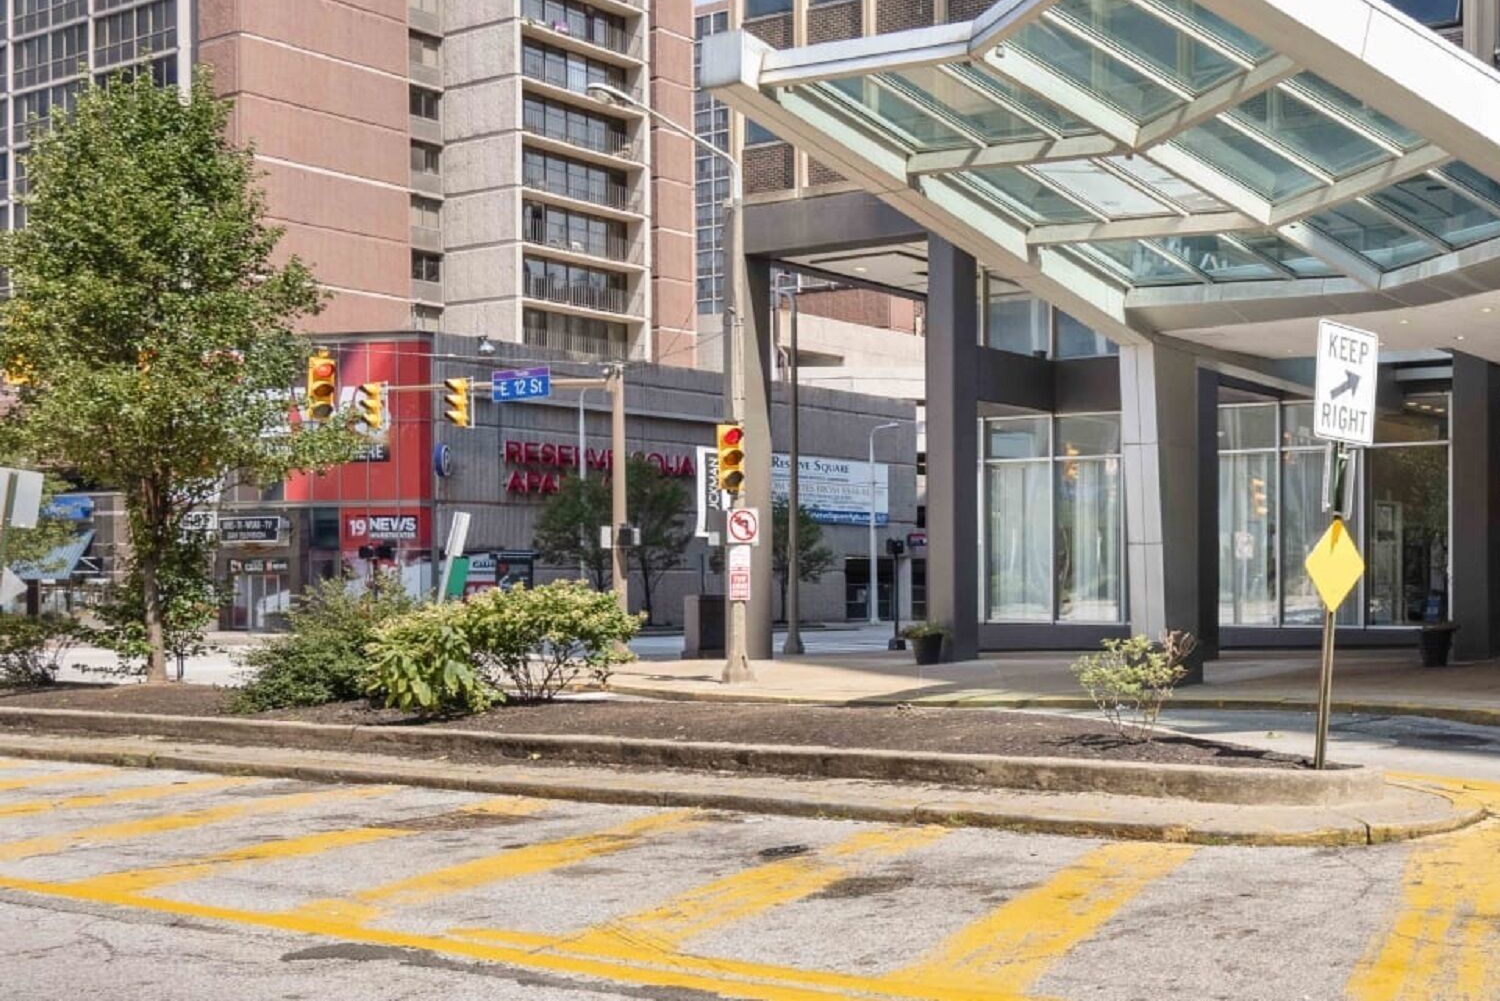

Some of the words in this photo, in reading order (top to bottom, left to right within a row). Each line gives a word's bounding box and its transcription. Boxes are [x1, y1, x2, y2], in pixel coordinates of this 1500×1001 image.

[1329, 332, 1370, 365] KEEP
[500, 381, 510, 396] E
[514, 379, 526, 395] 12
[530, 378, 543, 394] St
[1321, 402, 1368, 435] RIGHT
[349, 519, 367, 537] 19
[368, 516, 417, 531] NEWS
